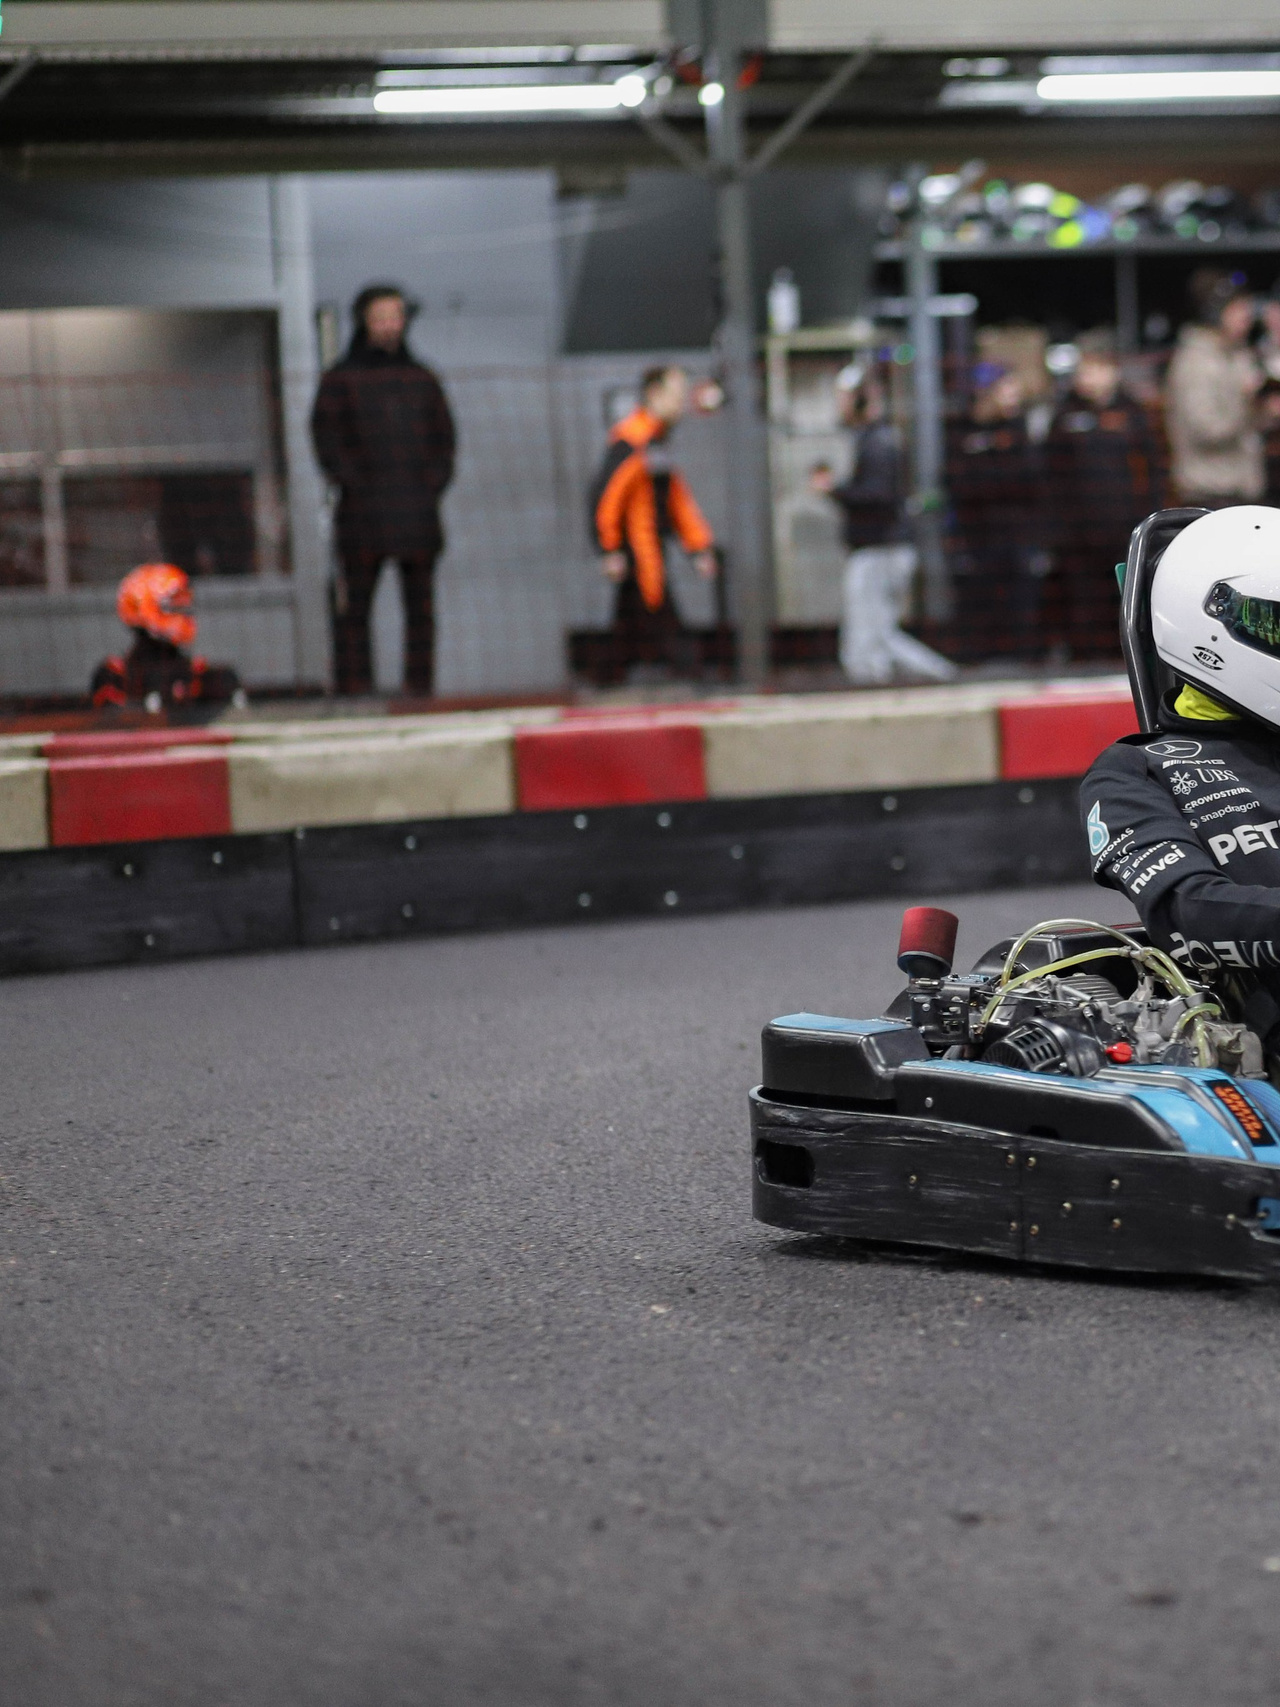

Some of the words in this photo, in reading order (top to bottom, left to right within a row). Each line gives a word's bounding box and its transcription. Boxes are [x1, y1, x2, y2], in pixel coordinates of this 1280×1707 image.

[1194, 767, 1240, 784] UBS
[1200, 800, 1261, 823] snapdragon
[1093, 827, 1135, 873] PETRONAS
[1130, 844, 1186, 895] nuvei
